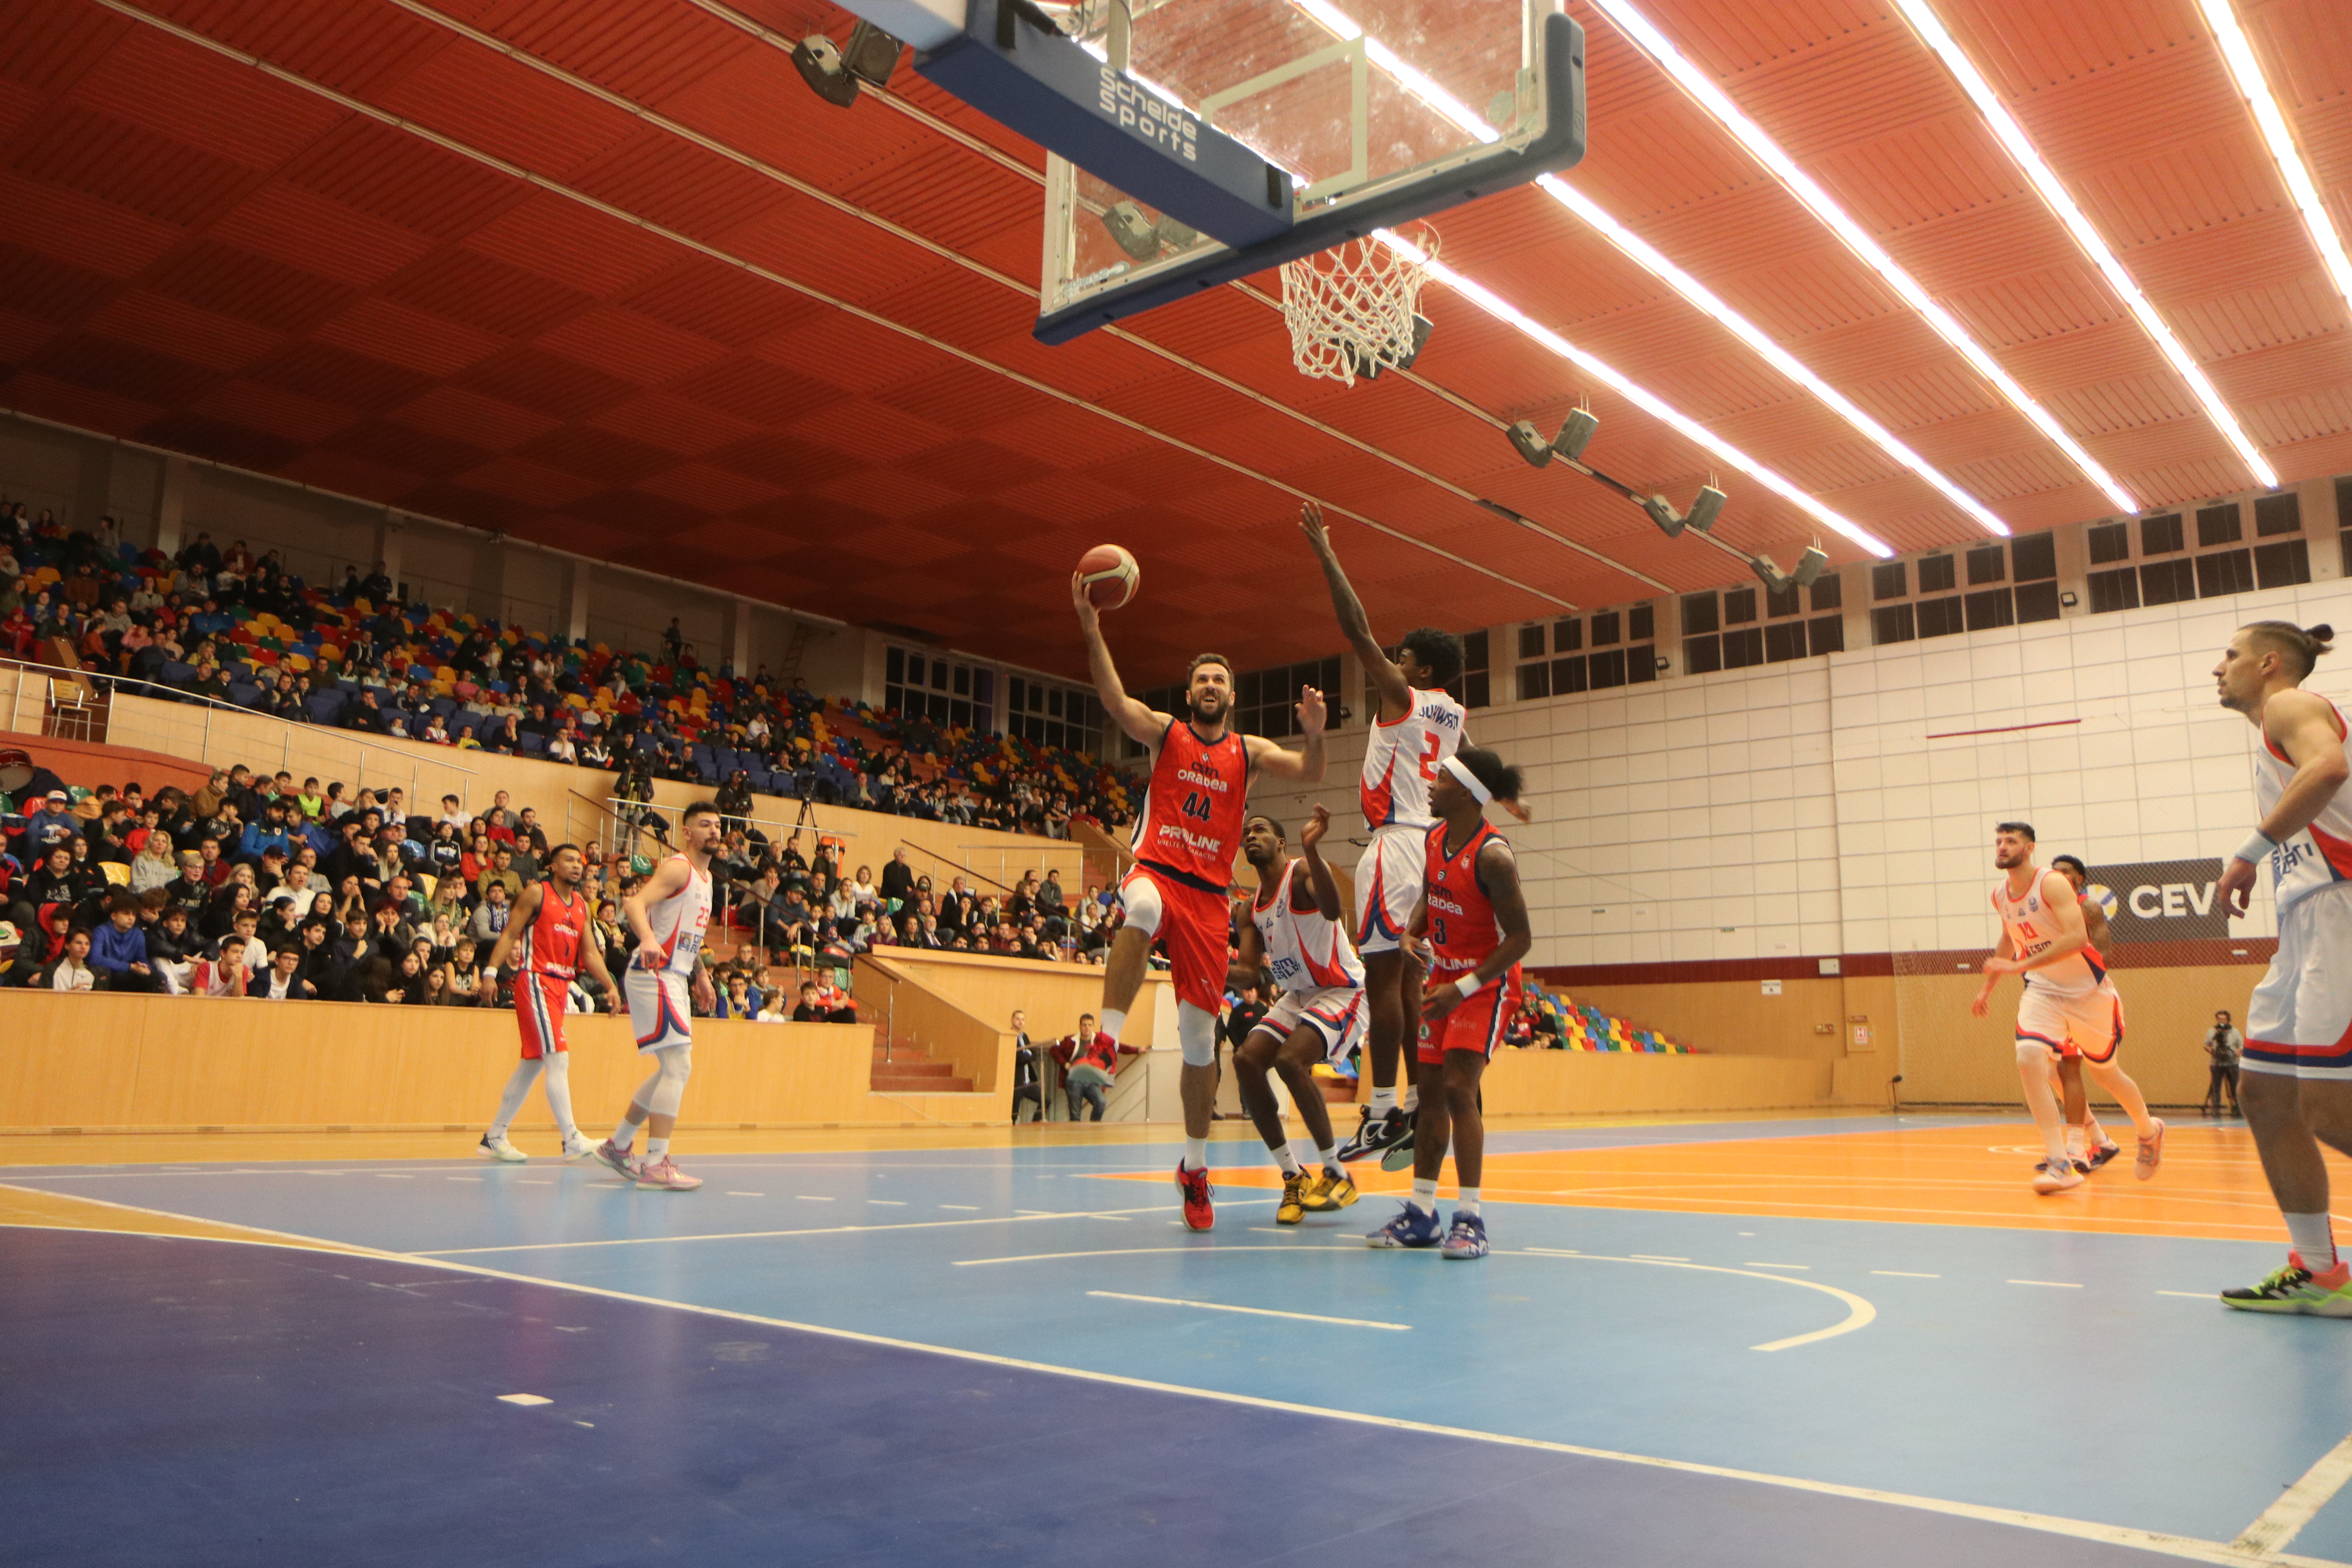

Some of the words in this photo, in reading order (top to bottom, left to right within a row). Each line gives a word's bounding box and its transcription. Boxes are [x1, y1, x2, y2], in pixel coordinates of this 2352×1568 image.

[1100, 67, 1196, 142] Schelde
[1100, 88, 1196, 162] Sports
[1419, 731, 1440, 781] 2
[1181, 791, 1211, 822] 44
[2129, 881, 2216, 918] CEV
[1434, 918, 1446, 945] 3
[2017, 922, 2039, 940] 10
